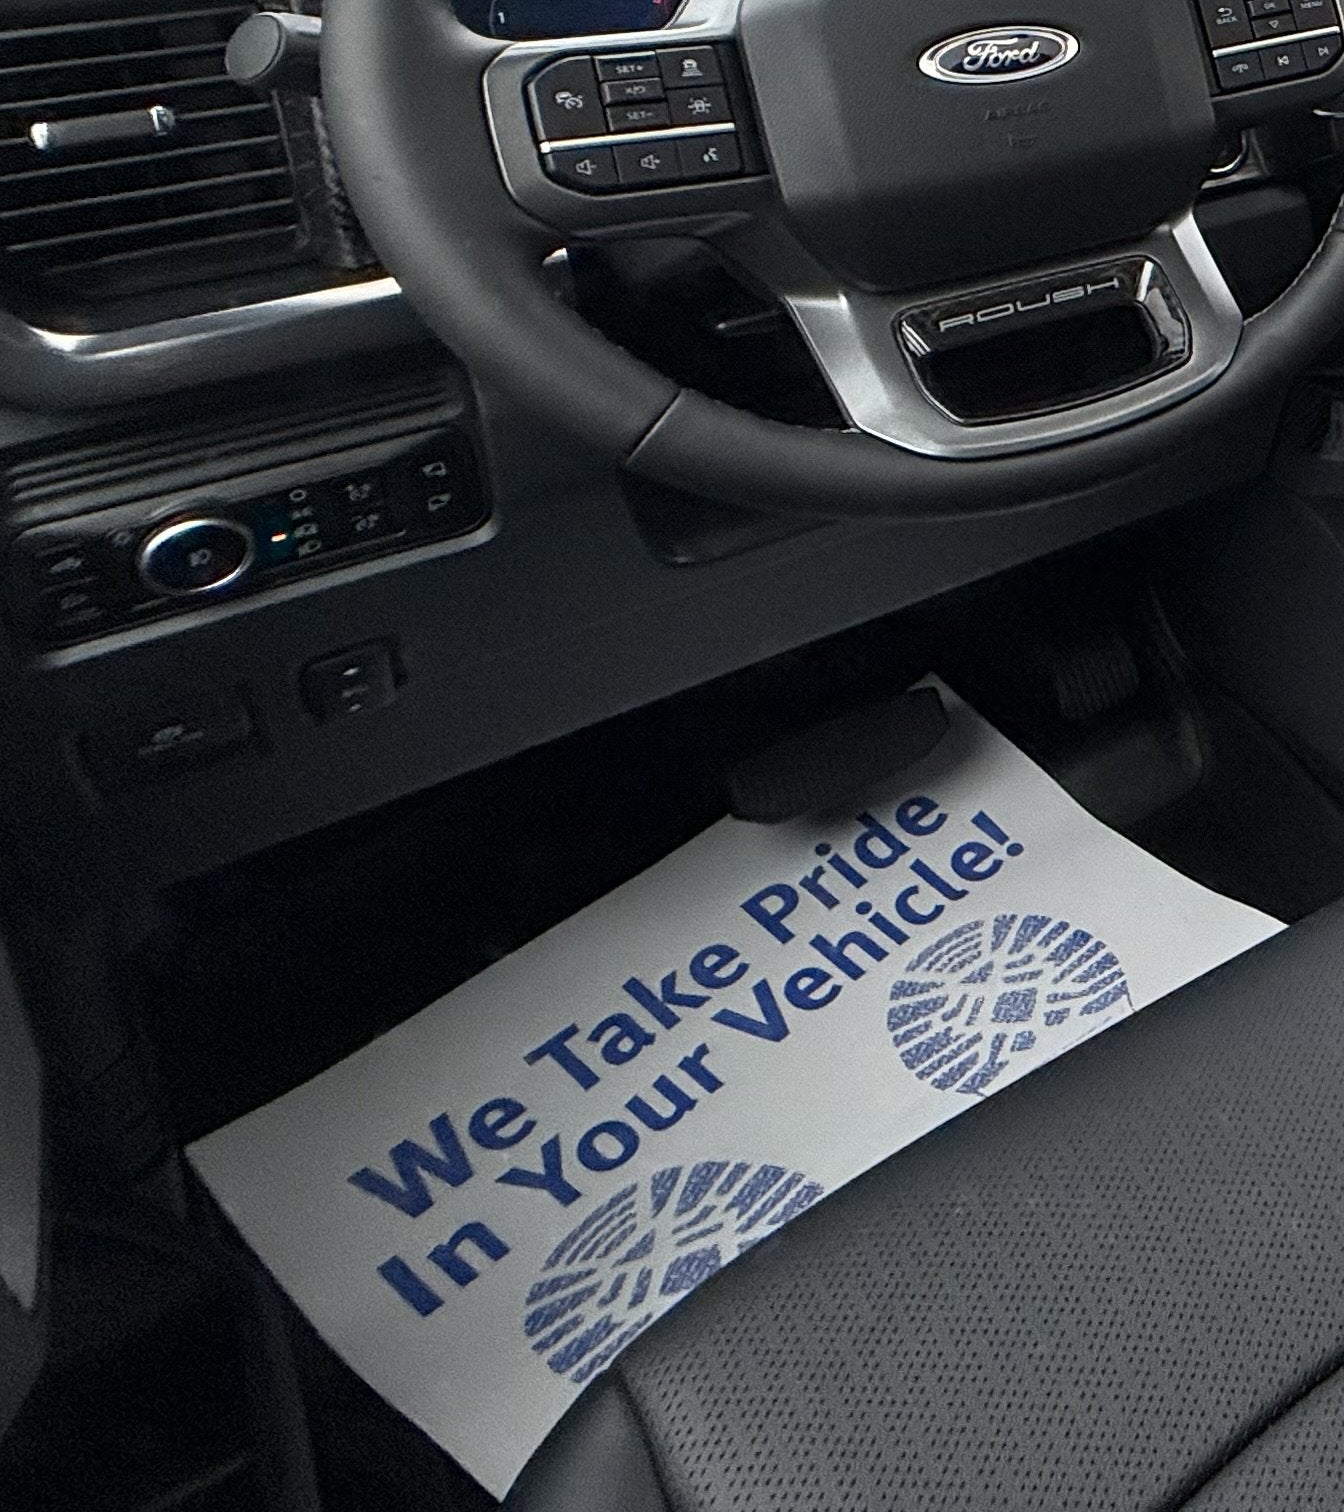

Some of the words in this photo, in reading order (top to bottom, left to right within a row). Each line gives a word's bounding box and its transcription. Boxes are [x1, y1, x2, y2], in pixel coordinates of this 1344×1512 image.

[497, 11, 505, 24] 1
[1215, 15, 1238, 25] BACK
[962, 37, 1041, 71] Ford
[939, 277, 1119, 332] ROUSH
[347, 1096, 537, 1218] We
[523, 943, 750, 1091] Take
[740, 795, 949, 945] Pride
[376, 1221, 511, 1318] In
[494, 1042, 724, 1208] Your
[710, 810, 1025, 1043] Vehicle!
